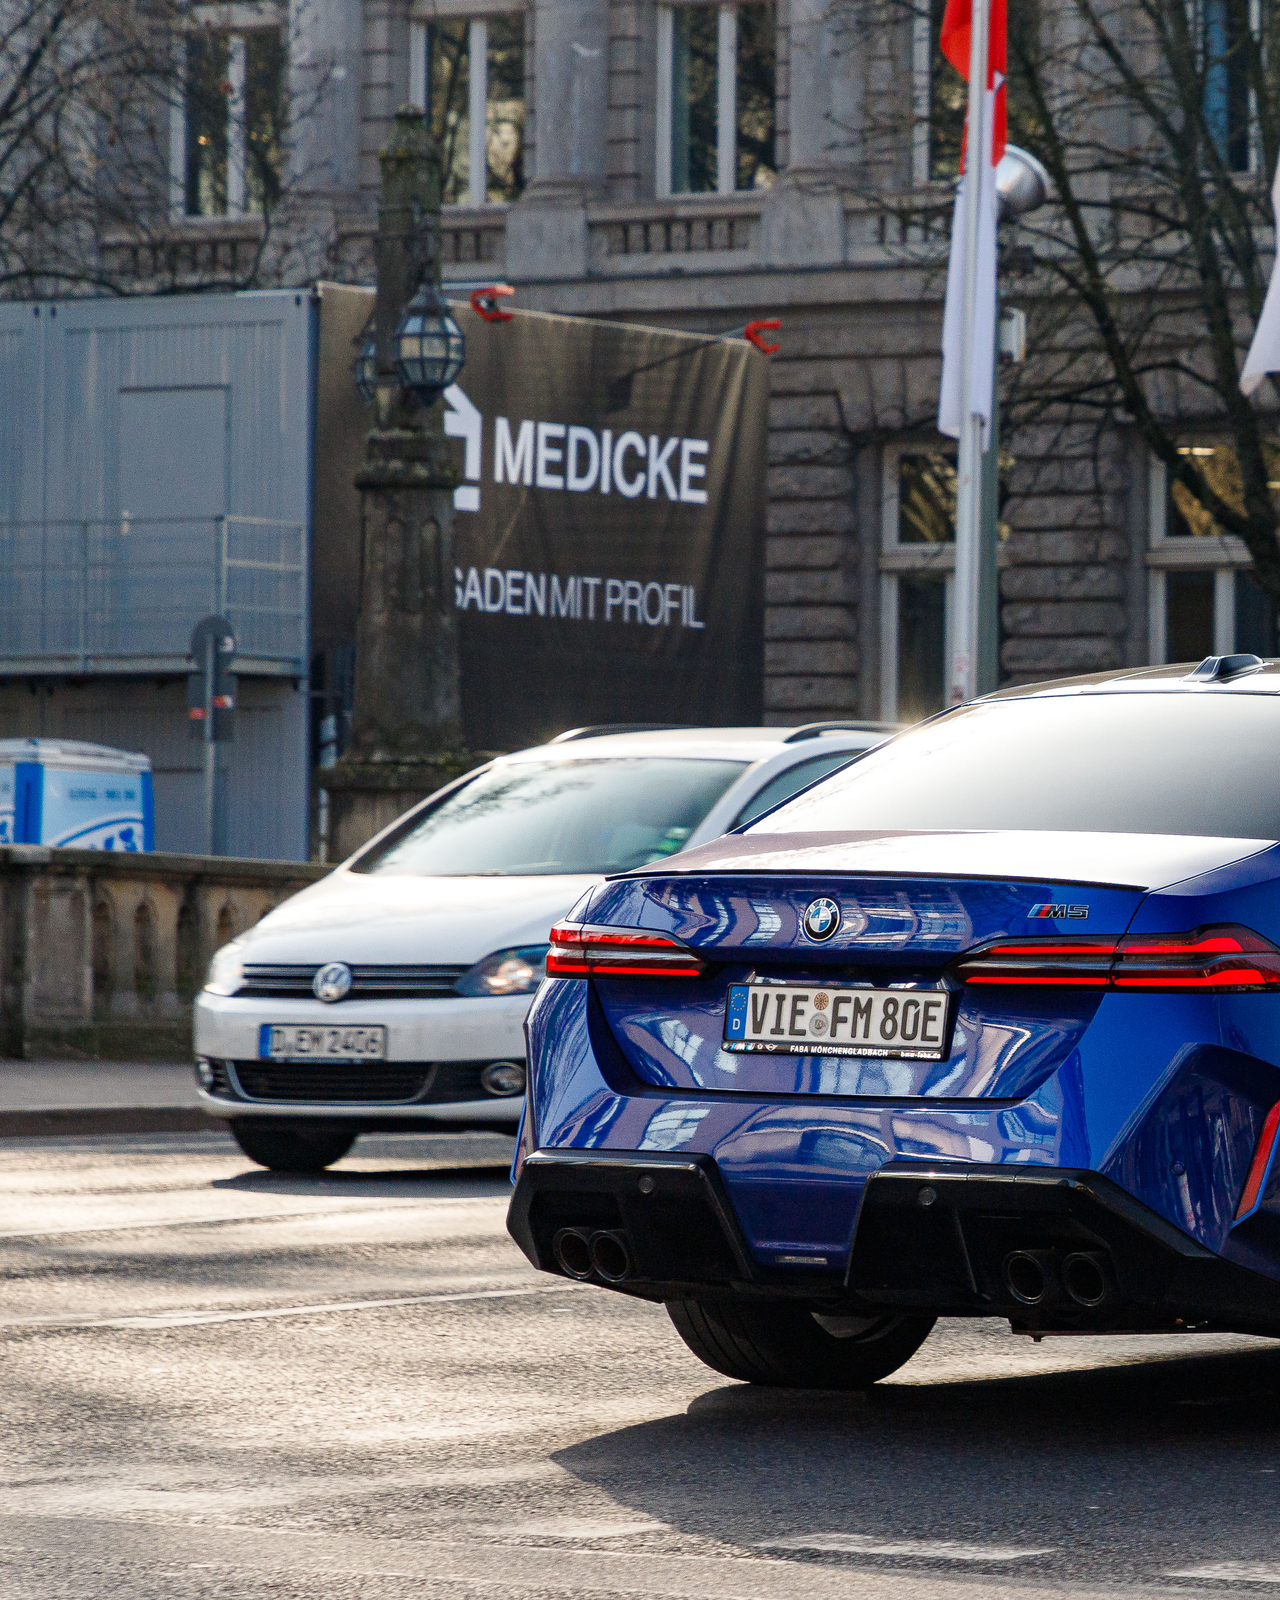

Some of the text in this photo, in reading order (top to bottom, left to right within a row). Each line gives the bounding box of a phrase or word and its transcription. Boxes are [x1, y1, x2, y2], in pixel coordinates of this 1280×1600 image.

[494, 416, 709, 505] MEDICKE
[550, 573, 602, 621] MIT
[604, 578, 706, 630] PROFIL
[731, 1018, 741, 1030] D
[751, 992, 942, 1042] VIE FM 80E
[790, 1045, 809, 1053] FABA
[810, 1046, 889, 1057] MÖNCHENGLADBACH
